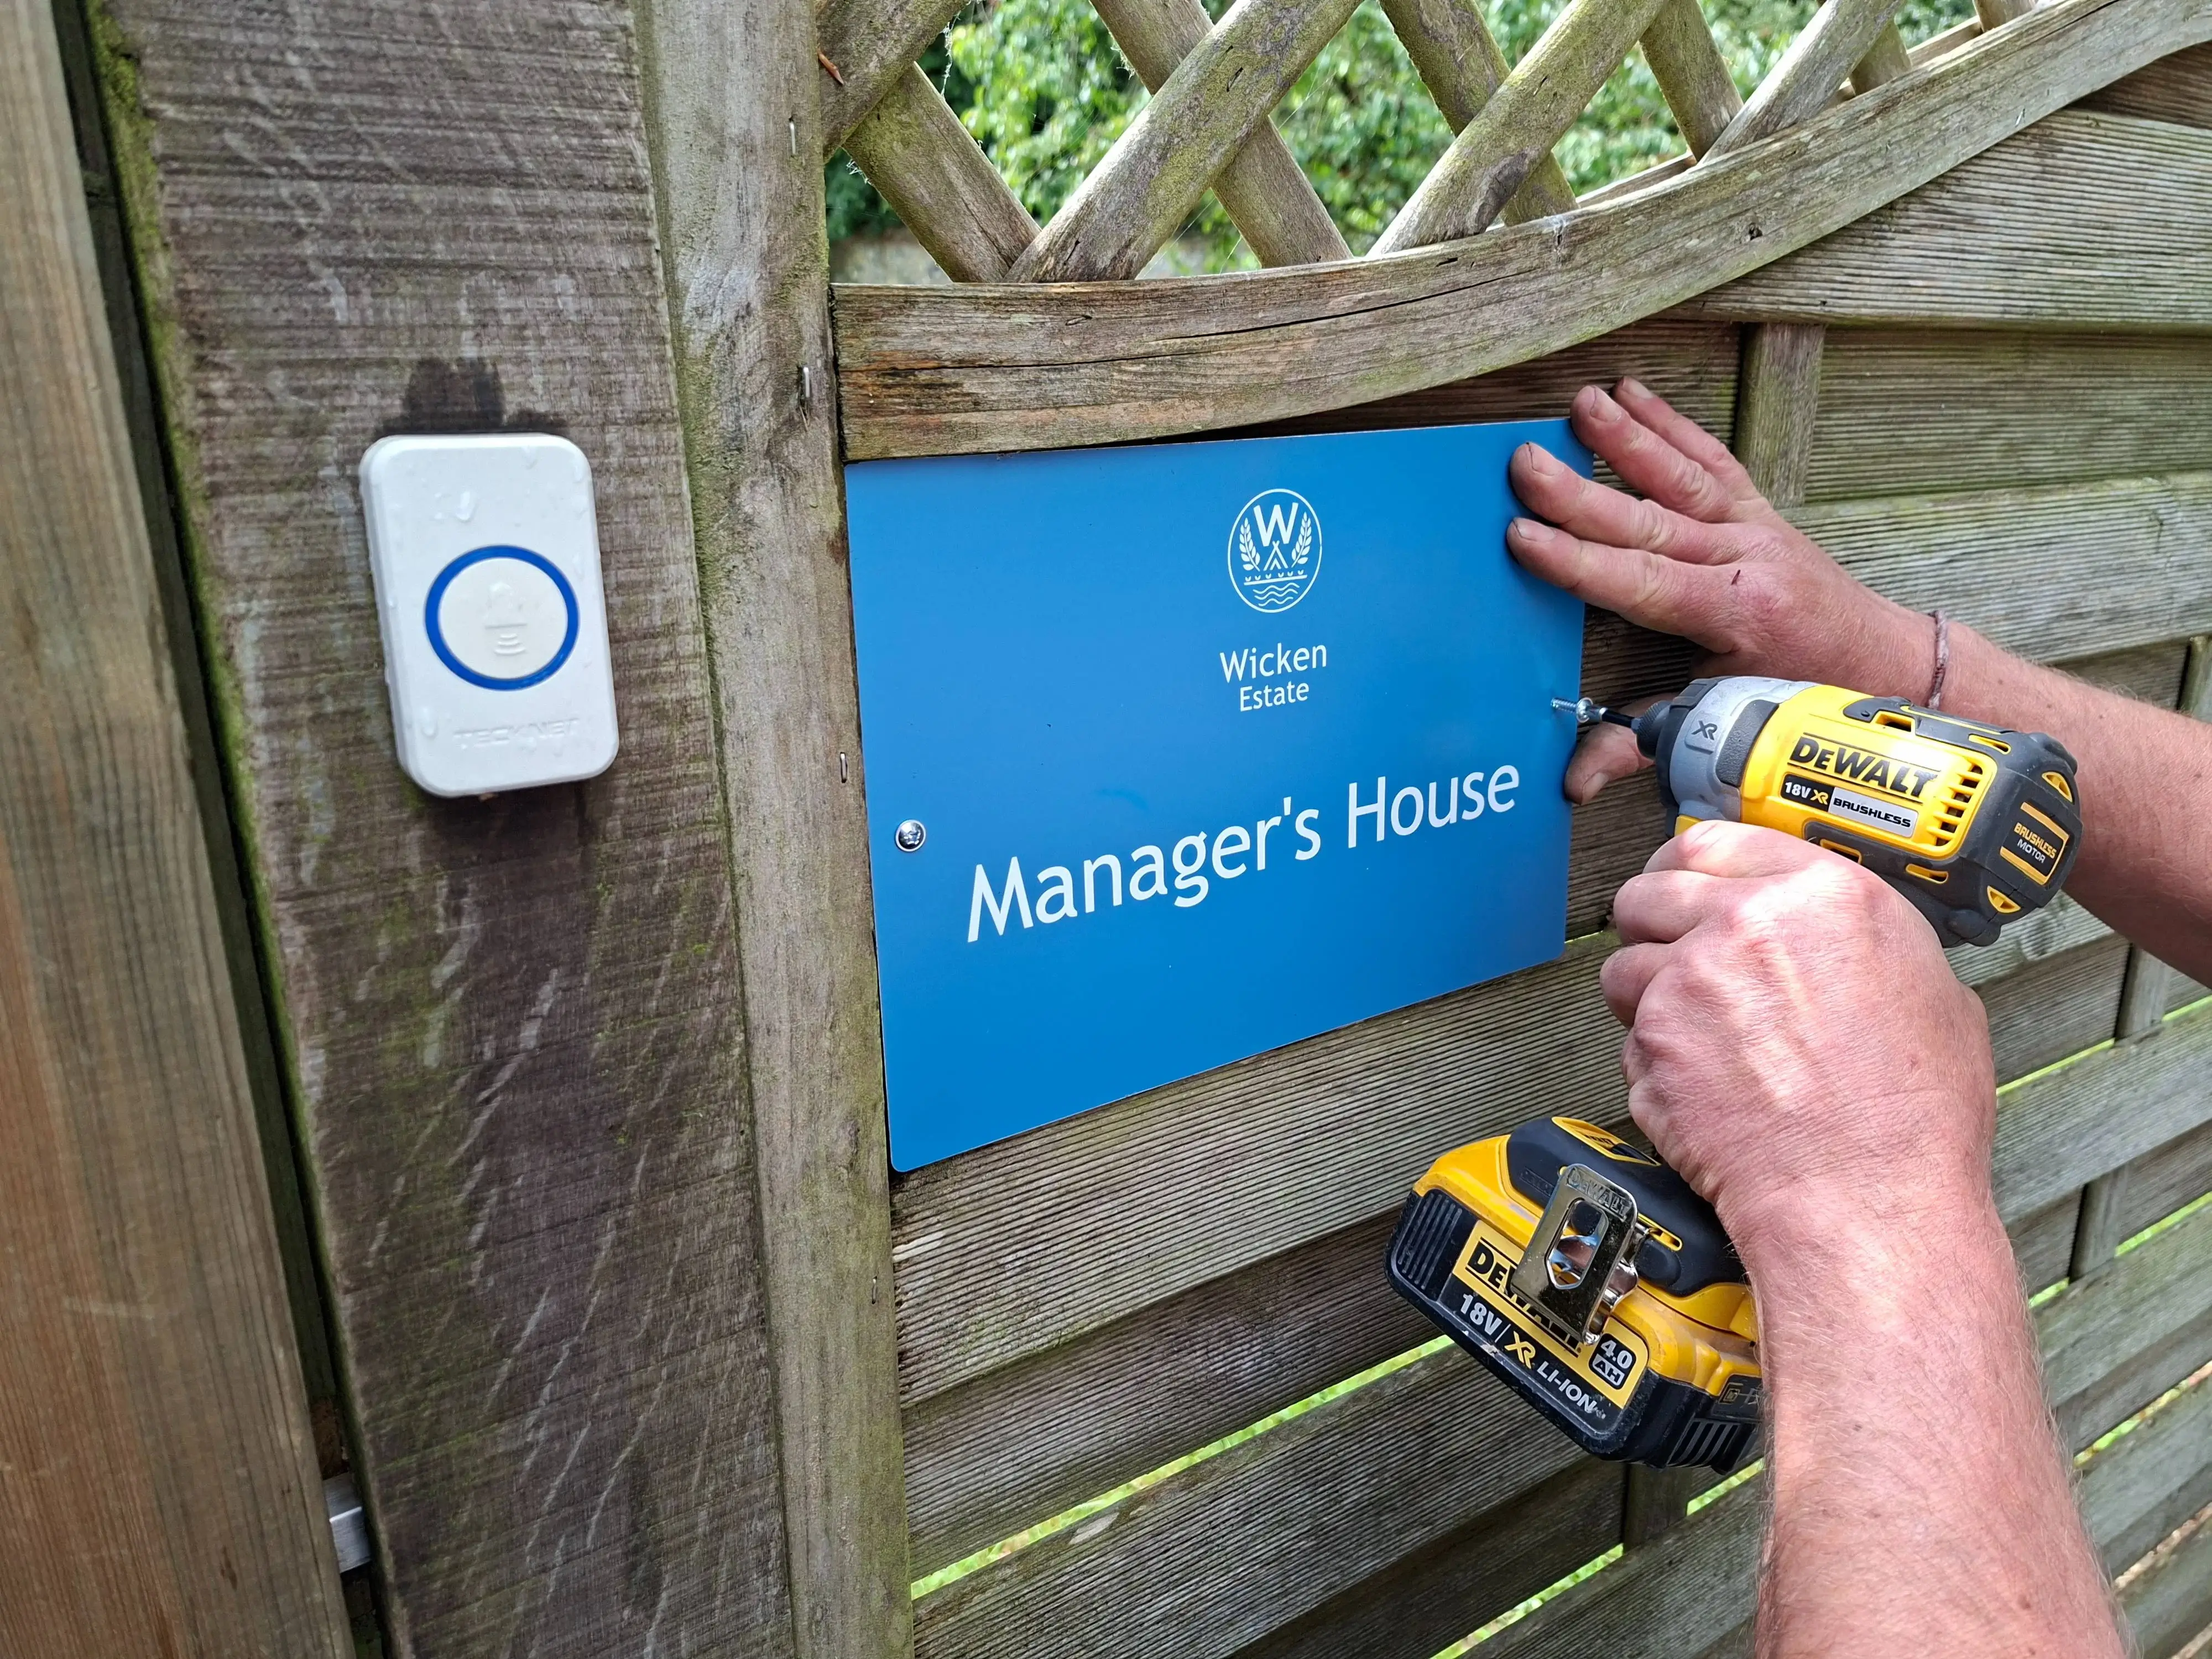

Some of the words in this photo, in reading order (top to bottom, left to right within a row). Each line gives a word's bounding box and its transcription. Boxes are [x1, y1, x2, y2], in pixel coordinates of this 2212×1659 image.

[1219, 643, 1327, 683] Wicken
[1240, 681, 1310, 712] Estate
[1692, 721, 1718, 740] XR
[1790, 736, 1938, 797] DEWALT
[1785, 781, 1811, 798] 18V
[1811, 789, 1829, 805] XR
[1833, 797, 1911, 828] BRUSHLESS
[967, 796, 1321, 943] Manager's
[1348, 765, 1520, 848] House
[2013, 822, 2057, 859] BRUSHLESS
[2017, 838, 2046, 863] MOTOR
[1460, 1294, 1502, 1335] 18V
[1504, 1331, 1536, 1369] XR
[1537, 1361, 1598, 1413] LI-ION
[1600, 1339, 1632, 1368] 4.0
